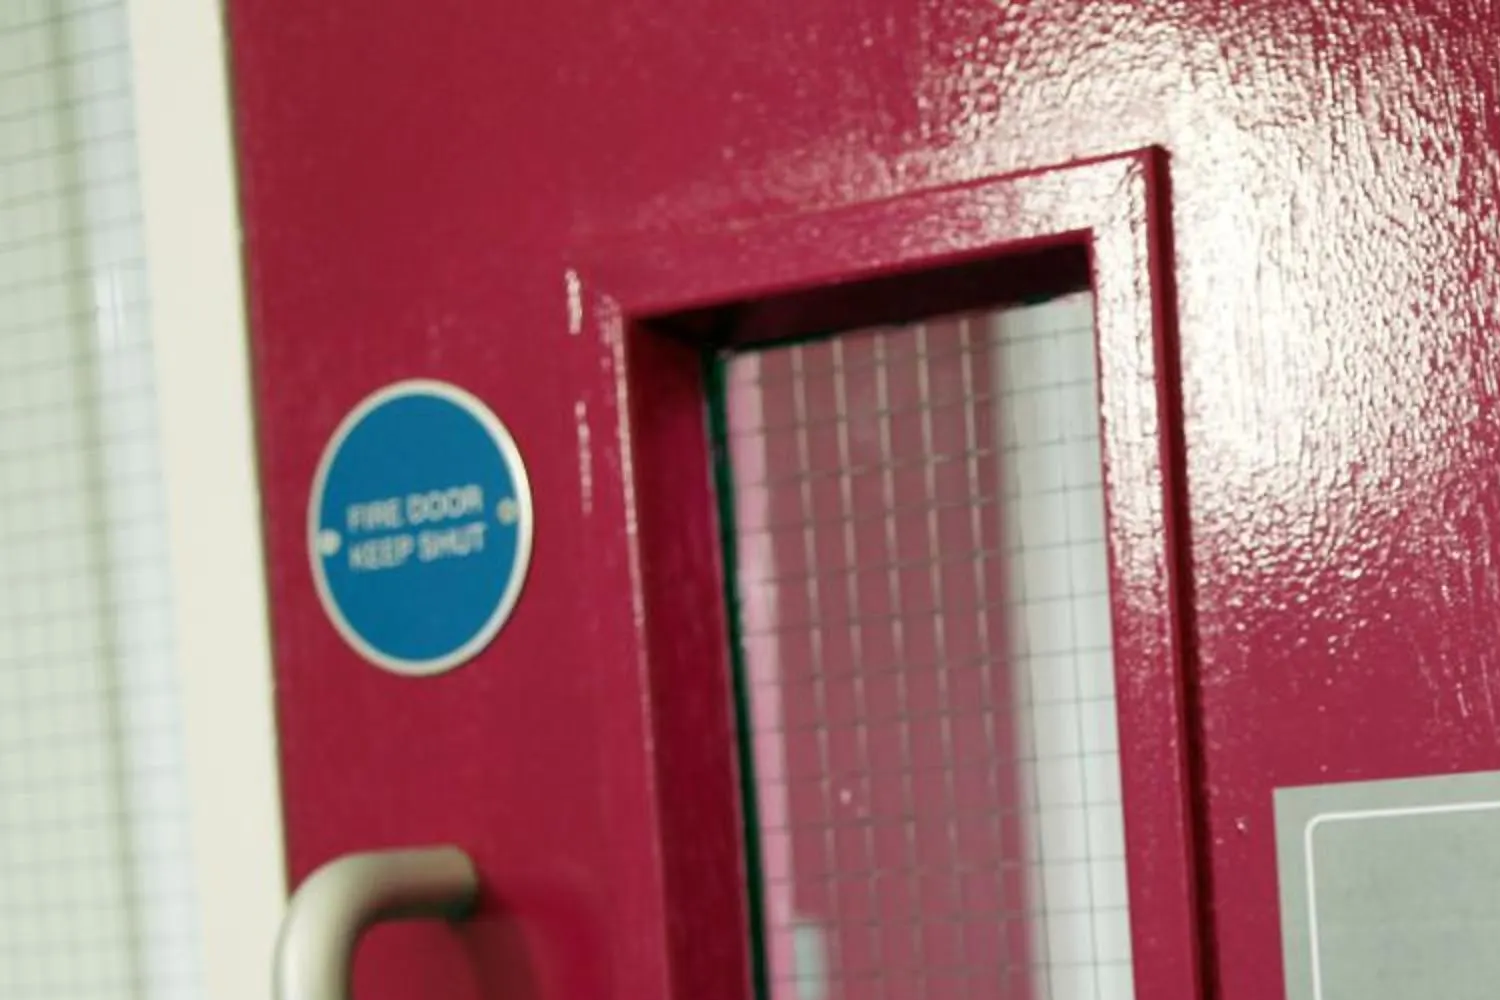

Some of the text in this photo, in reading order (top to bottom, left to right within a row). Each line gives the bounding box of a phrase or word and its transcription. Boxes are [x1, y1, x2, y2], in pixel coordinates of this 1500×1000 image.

[347, 484, 483, 532] FIRE DOOR
[348, 521, 487, 571] KEEP SHUT
